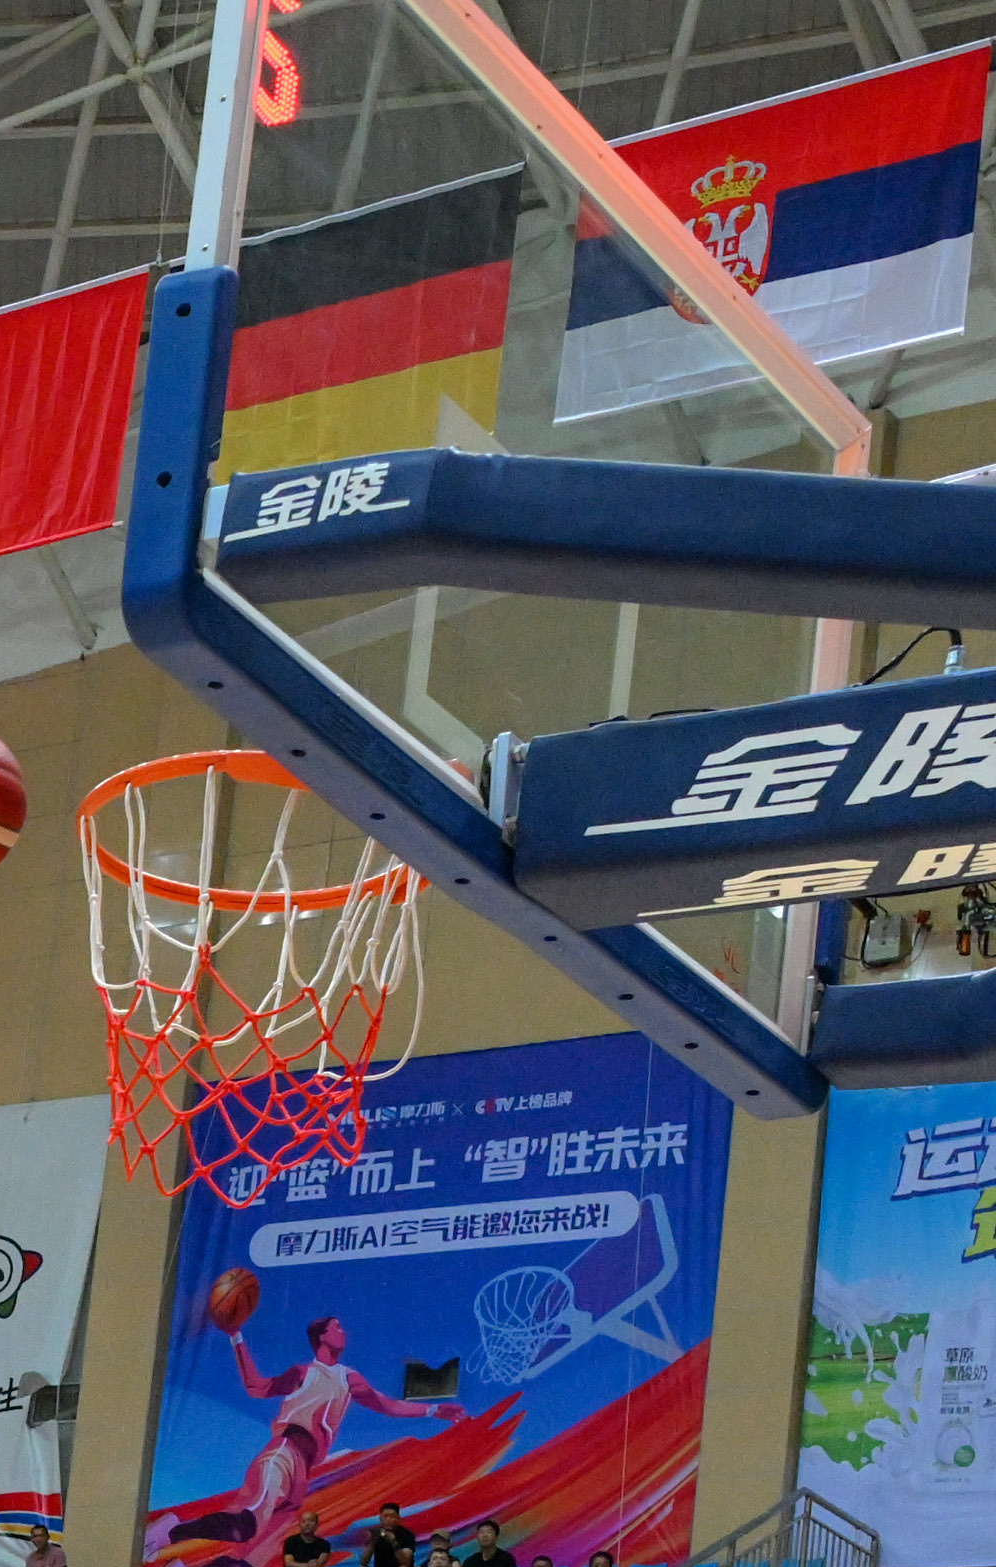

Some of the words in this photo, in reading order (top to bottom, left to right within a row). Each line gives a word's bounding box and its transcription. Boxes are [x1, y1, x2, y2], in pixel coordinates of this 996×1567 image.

[223, 461, 411, 543] 金陵
[890, 1116, 996, 1202] 运
[274, 1211, 611, 1258] 摩力斯AI空气能邀您来战!
